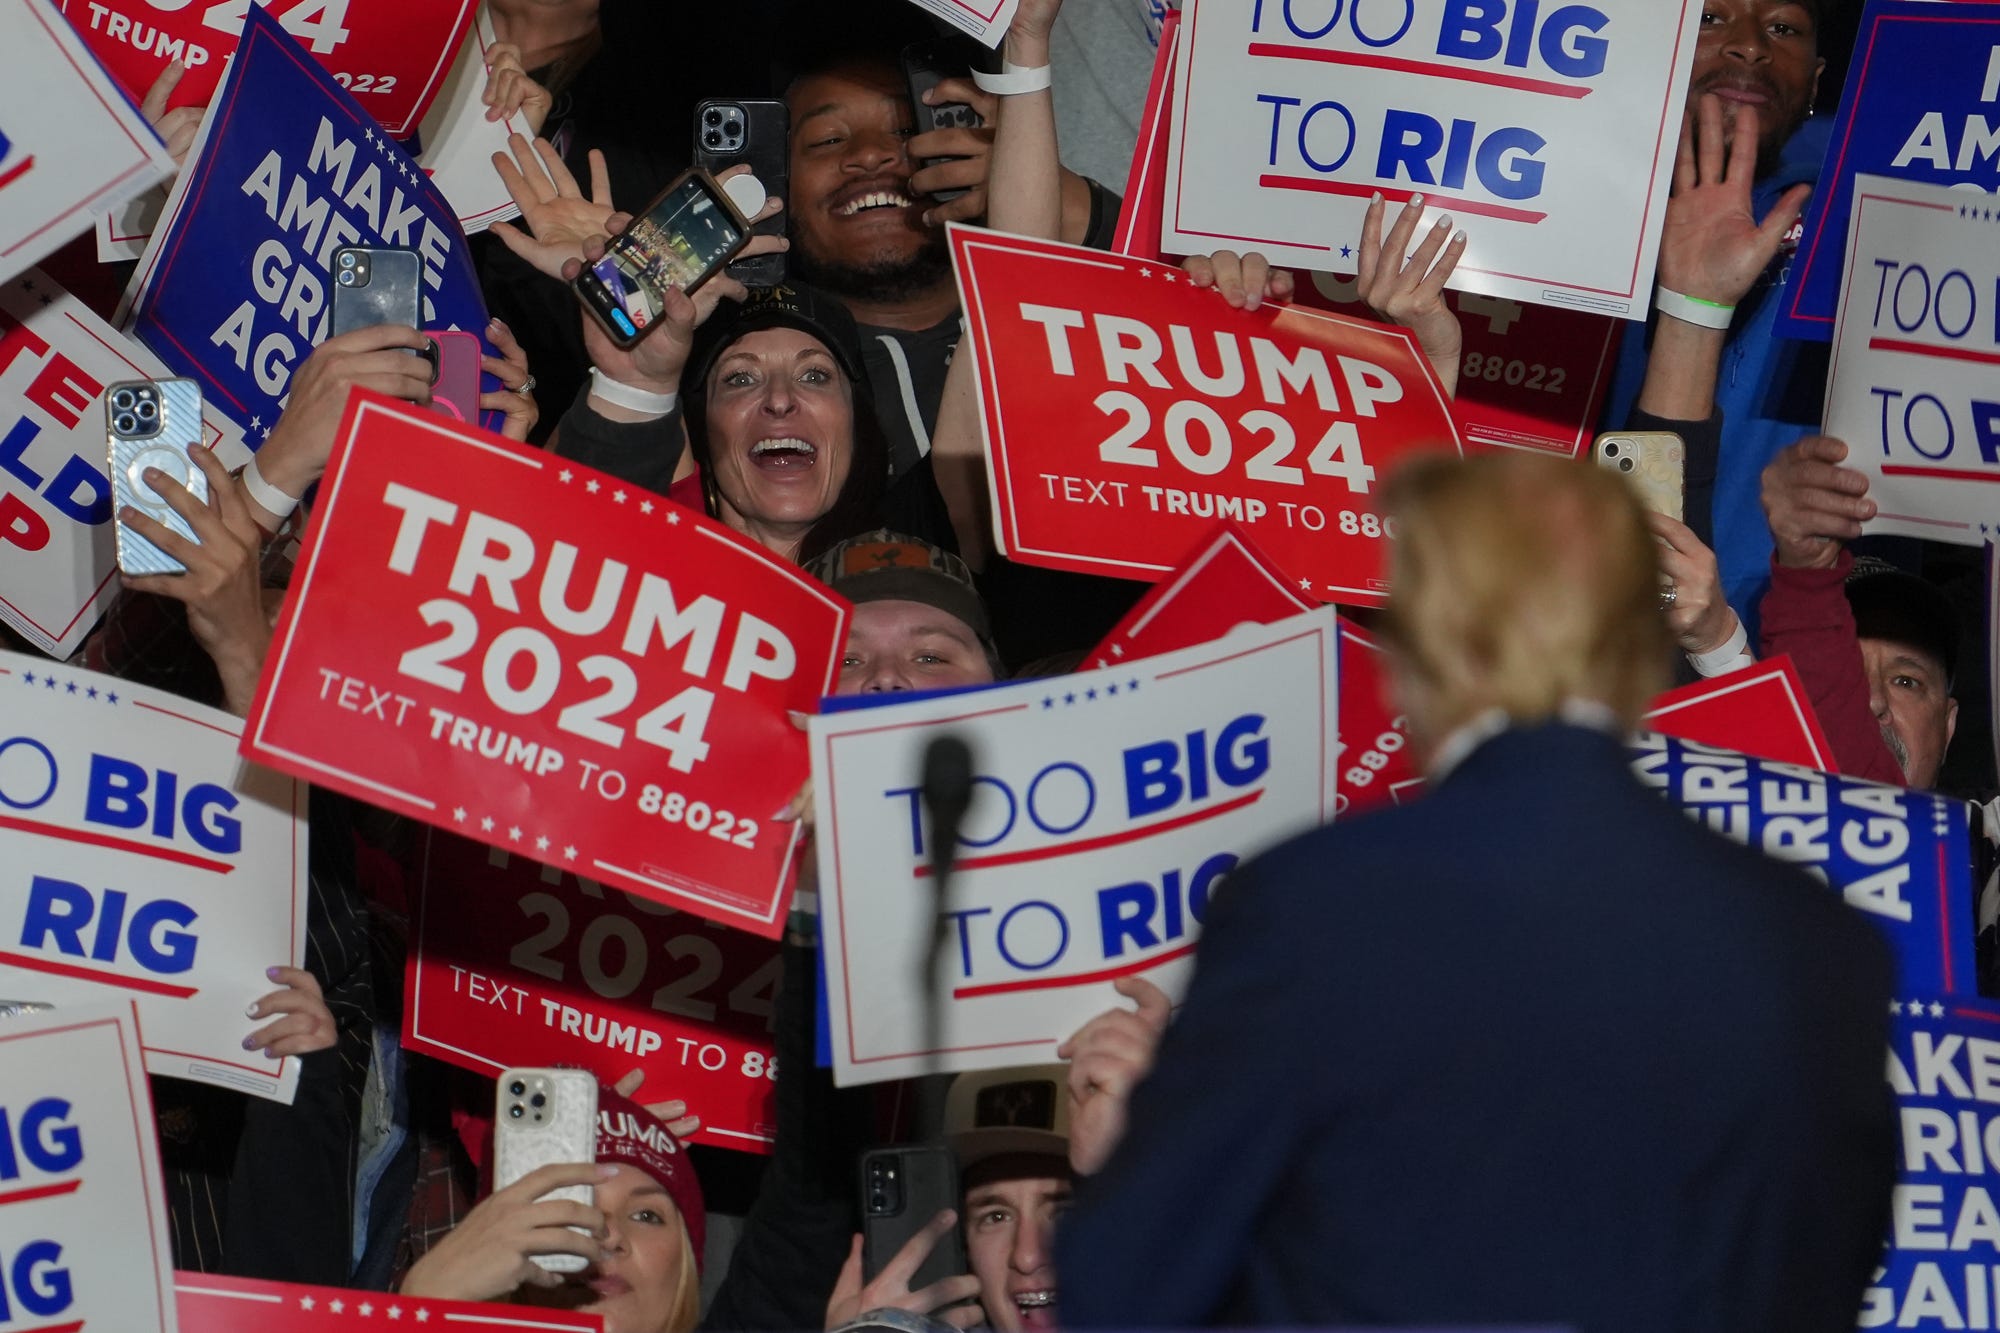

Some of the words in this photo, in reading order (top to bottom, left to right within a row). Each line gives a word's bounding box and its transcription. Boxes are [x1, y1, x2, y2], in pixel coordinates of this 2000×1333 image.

[87, 2, 209, 69] TRUMP
[1436, 0, 1611, 78] BIG
[1257, 94, 1356, 173] TO
[1375, 109, 1547, 200] RIG
[240, 149, 373, 274] AME
[307, 115, 451, 291] MAKE
[252, 240, 330, 347] GR
[1873, 257, 1977, 339] TOO
[209, 299, 297, 402] AG
[1018, 302, 1404, 418] TRUMP
[1463, 352, 1566, 394] 88022
[1093, 390, 1376, 495] 2024
[1870, 386, 1955, 461] TO
[1039, 473, 1129, 509] TEXT
[1142, 486, 1267, 524] TRUMP
[1278, 502, 1325, 531] TO
[383, 481, 797, 692] TRUMP
[398, 598, 716, 774] 2024
[84, 752, 241, 854] BIG
[318, 667, 416, 727] TEXT
[429, 707, 564, 776] TRUMP
[578, 759, 626, 800] TO
[637, 784, 759, 849] 88022
[1123, 713, 1270, 819] BIG
[19, 875, 198, 974] RIG
[946, 900, 1069, 978] TO
[450, 965, 528, 1015] TEXT
[541, 999, 662, 1057] TRUMP
[676, 1037, 726, 1071] TO
